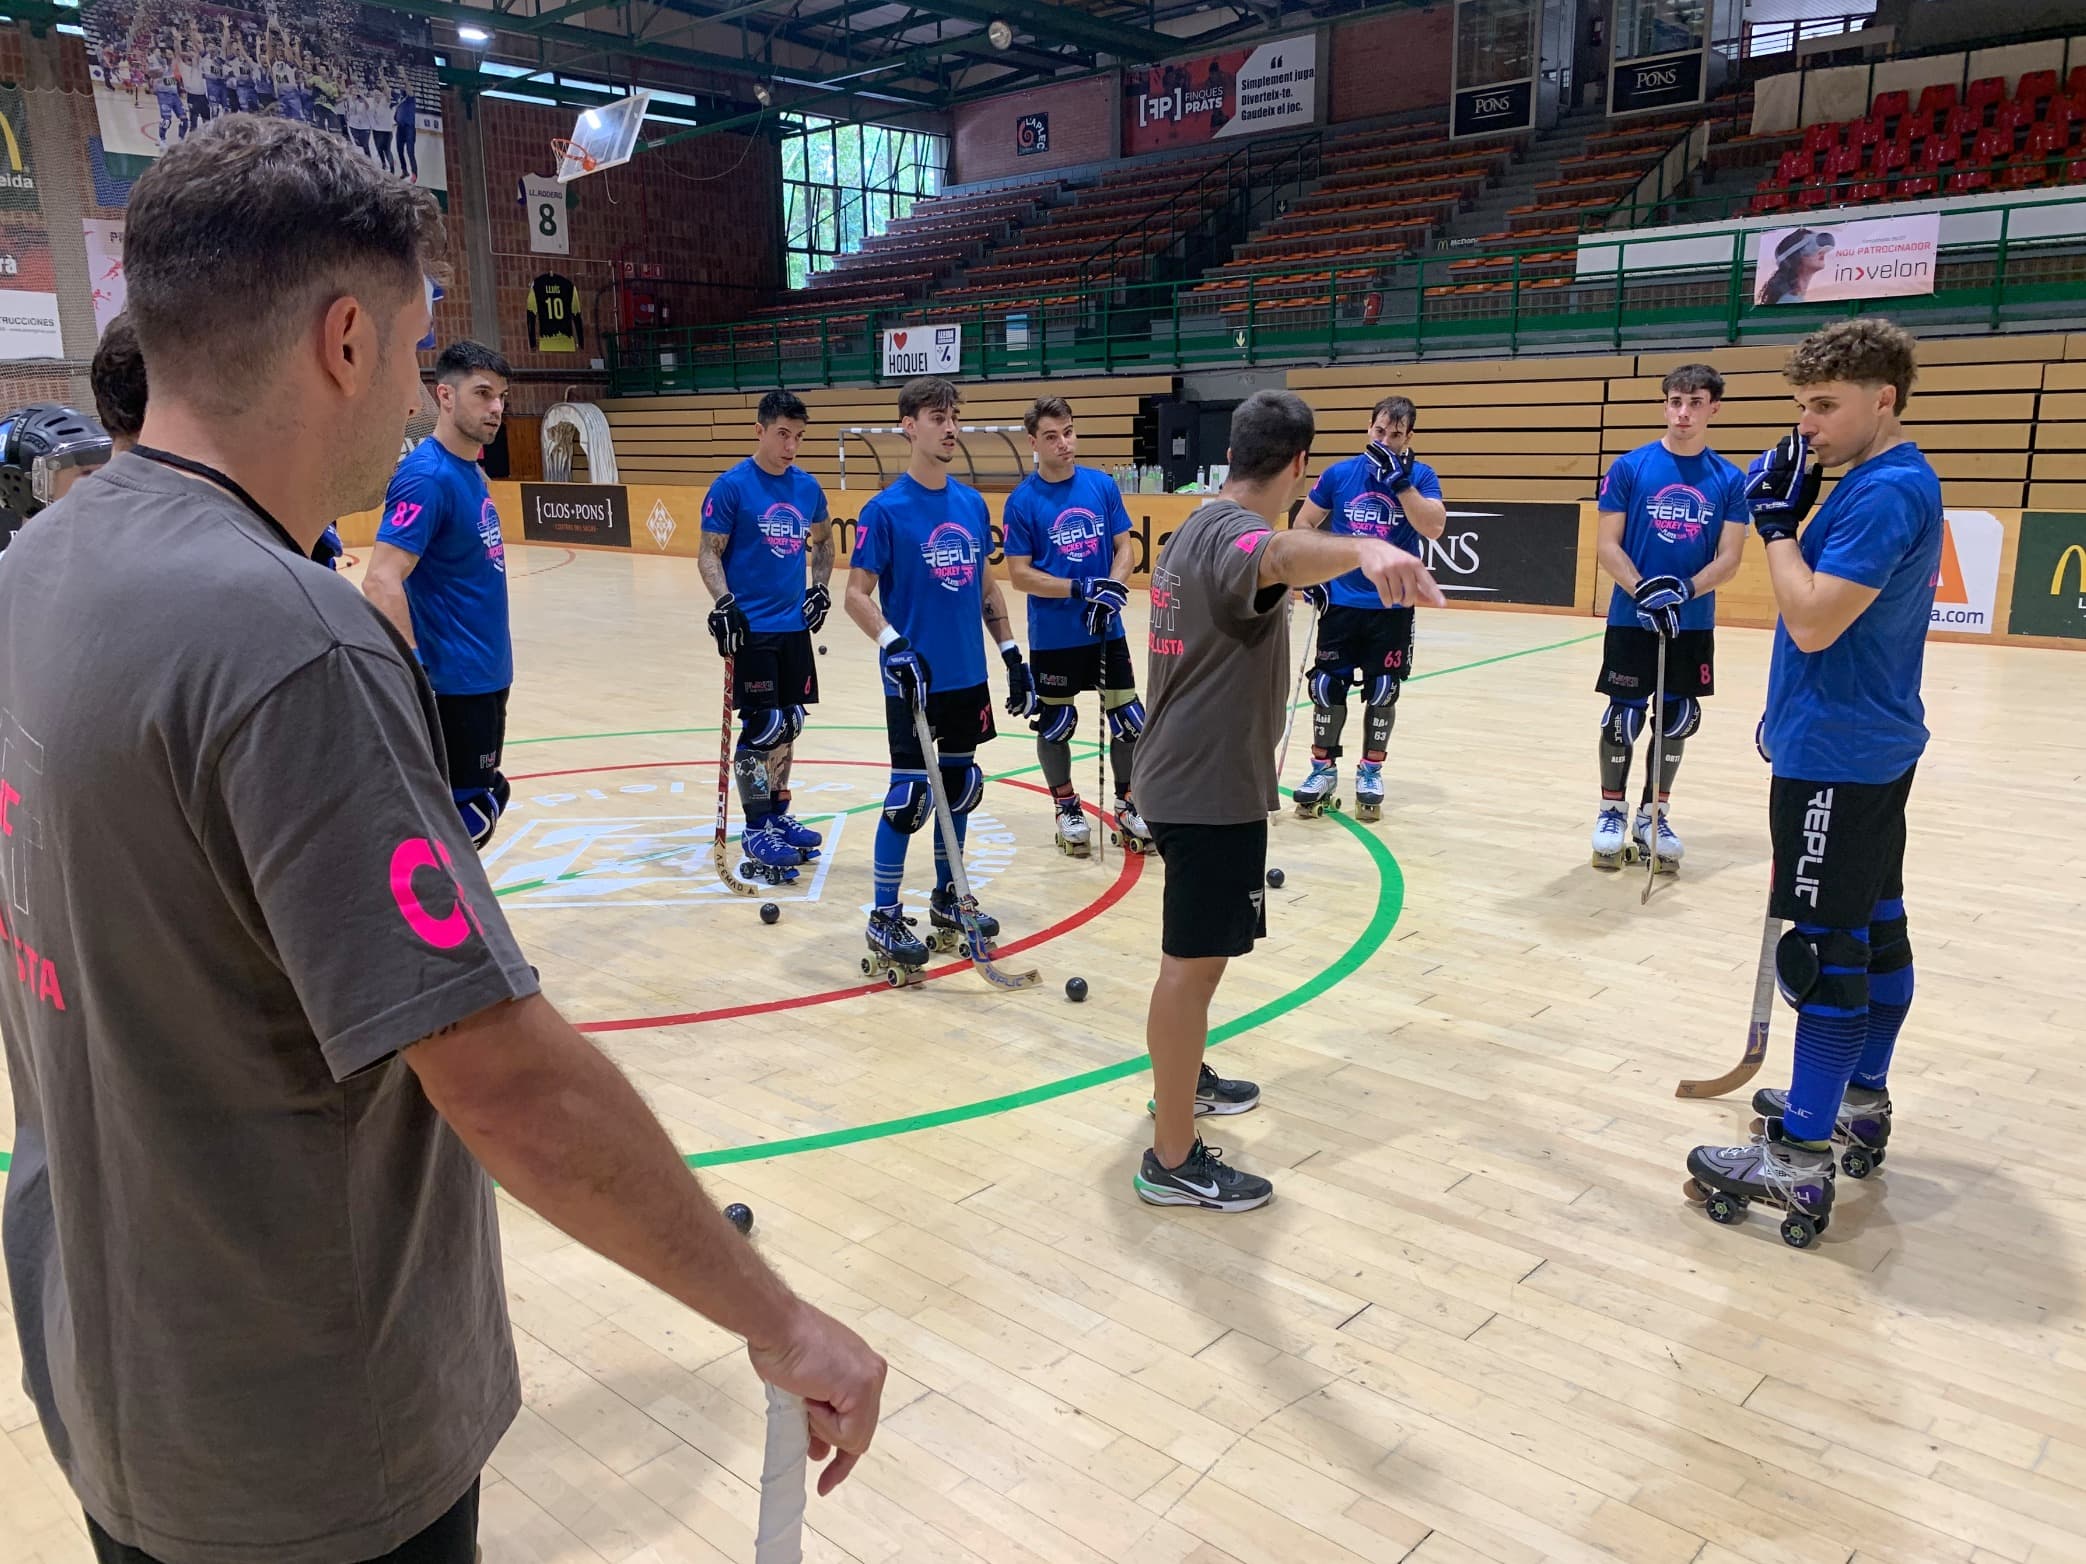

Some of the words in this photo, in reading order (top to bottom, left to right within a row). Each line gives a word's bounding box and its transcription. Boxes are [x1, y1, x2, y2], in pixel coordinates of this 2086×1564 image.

[1241, 71, 1293, 91] Simplement
[1294, 68, 1314, 82] juga
[1636, 69, 1677, 88] PONS
[1184, 86, 1224, 102] FINQUES
[1185, 97, 1223, 114] PRATS
[1241, 106, 1276, 121] Gaudeix
[1277, 103, 1286, 115] el
[1287, 102, 1304, 115] joc.
[1475, 96, 1510, 113] PONS
[539, 203, 557, 236] 8
[1857, 242, 1931, 256] PATROCINADOR
[545, 297, 564, 320] 10
[0, 315, 55, 328] TRUCCIONES
[888, 352, 928, 374] HOQUEI
[392, 501, 422, 528] 87
[705, 498, 714, 518] 6
[1646, 505, 1714, 525] REPLIC
[1419, 531, 1480, 574] NS
[1930, 608, 1985, 625] a.com
[1384, 650, 1402, 668] 63
[1700, 664, 1711, 685] 8
[804, 675, 812, 695] 6
[1374, 731, 1387, 741] 63
[1794, 787, 1834, 909] REPLIC
[984, 965, 1026, 988] REPLIC
